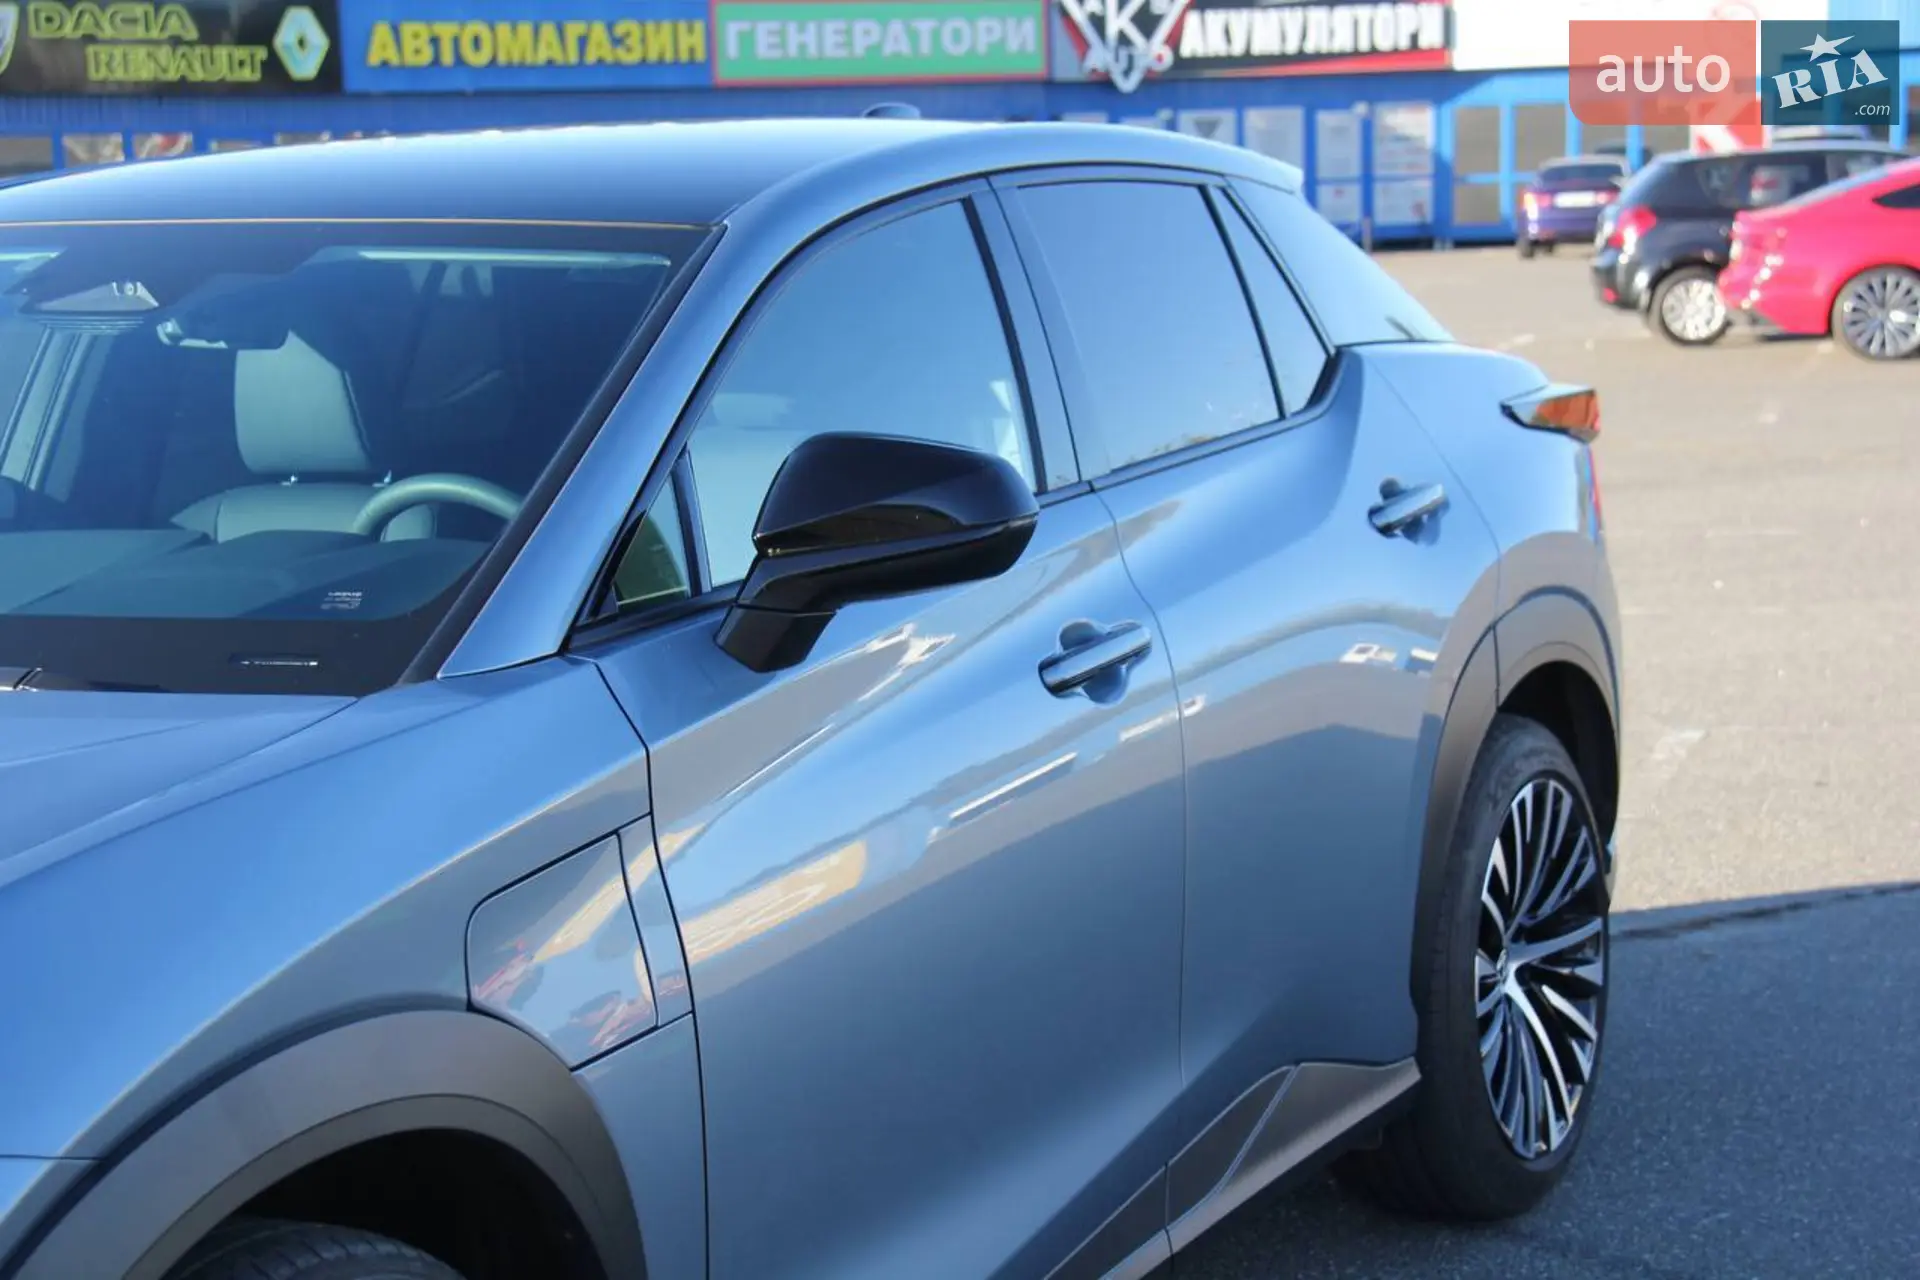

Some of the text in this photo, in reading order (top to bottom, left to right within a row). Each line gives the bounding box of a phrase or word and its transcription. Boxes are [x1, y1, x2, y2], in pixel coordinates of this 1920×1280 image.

[28, 2, 199, 39] DACIA
[725, 16, 1037, 60] ГЕНЕРАТОРИ
[1179, 4, 1444, 58] АКУМУЛЯТОРИ
[86, 44, 268, 82] RENAULT
[366, 20, 706, 67] АВТОМАГАЗИН
